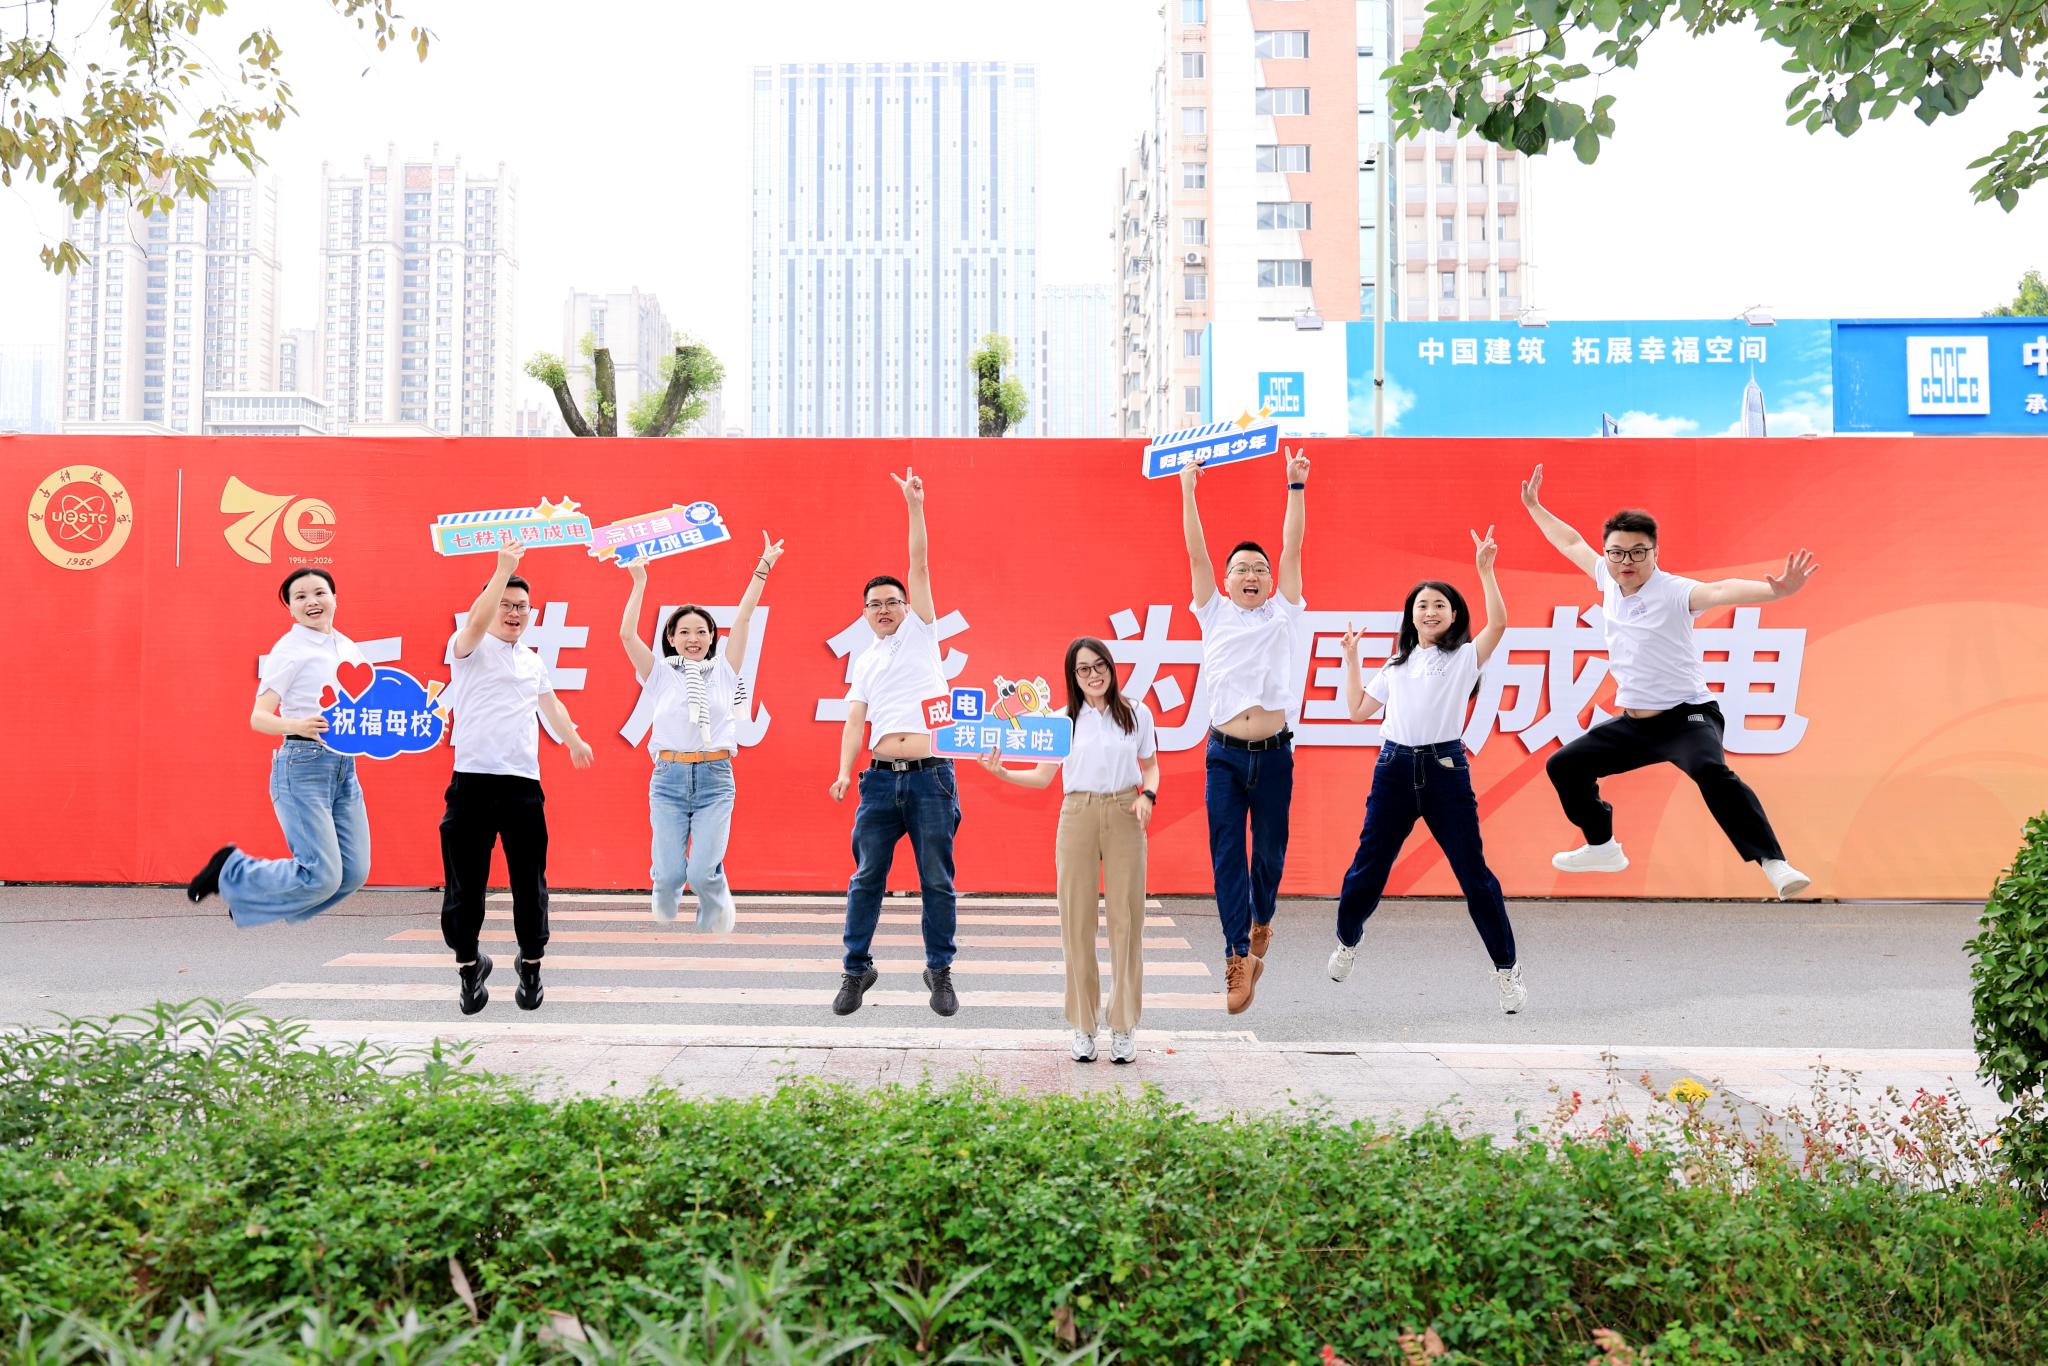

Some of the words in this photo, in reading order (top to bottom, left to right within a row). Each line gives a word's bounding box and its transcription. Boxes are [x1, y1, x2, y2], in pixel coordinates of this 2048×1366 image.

[1418, 336, 1546, 366] 中国建筑
[1572, 335, 1767, 364] 拓展幸福空间
[452, 523, 586, 549] 七秩礼赞成电
[604, 516, 673, 545] 念往昔
[635, 527, 705, 557] 忆成电
[66, 557, 93, 566] 1956
[331, 706, 433, 737] 祝福母校
[953, 725, 1054, 751] 我回家啦
